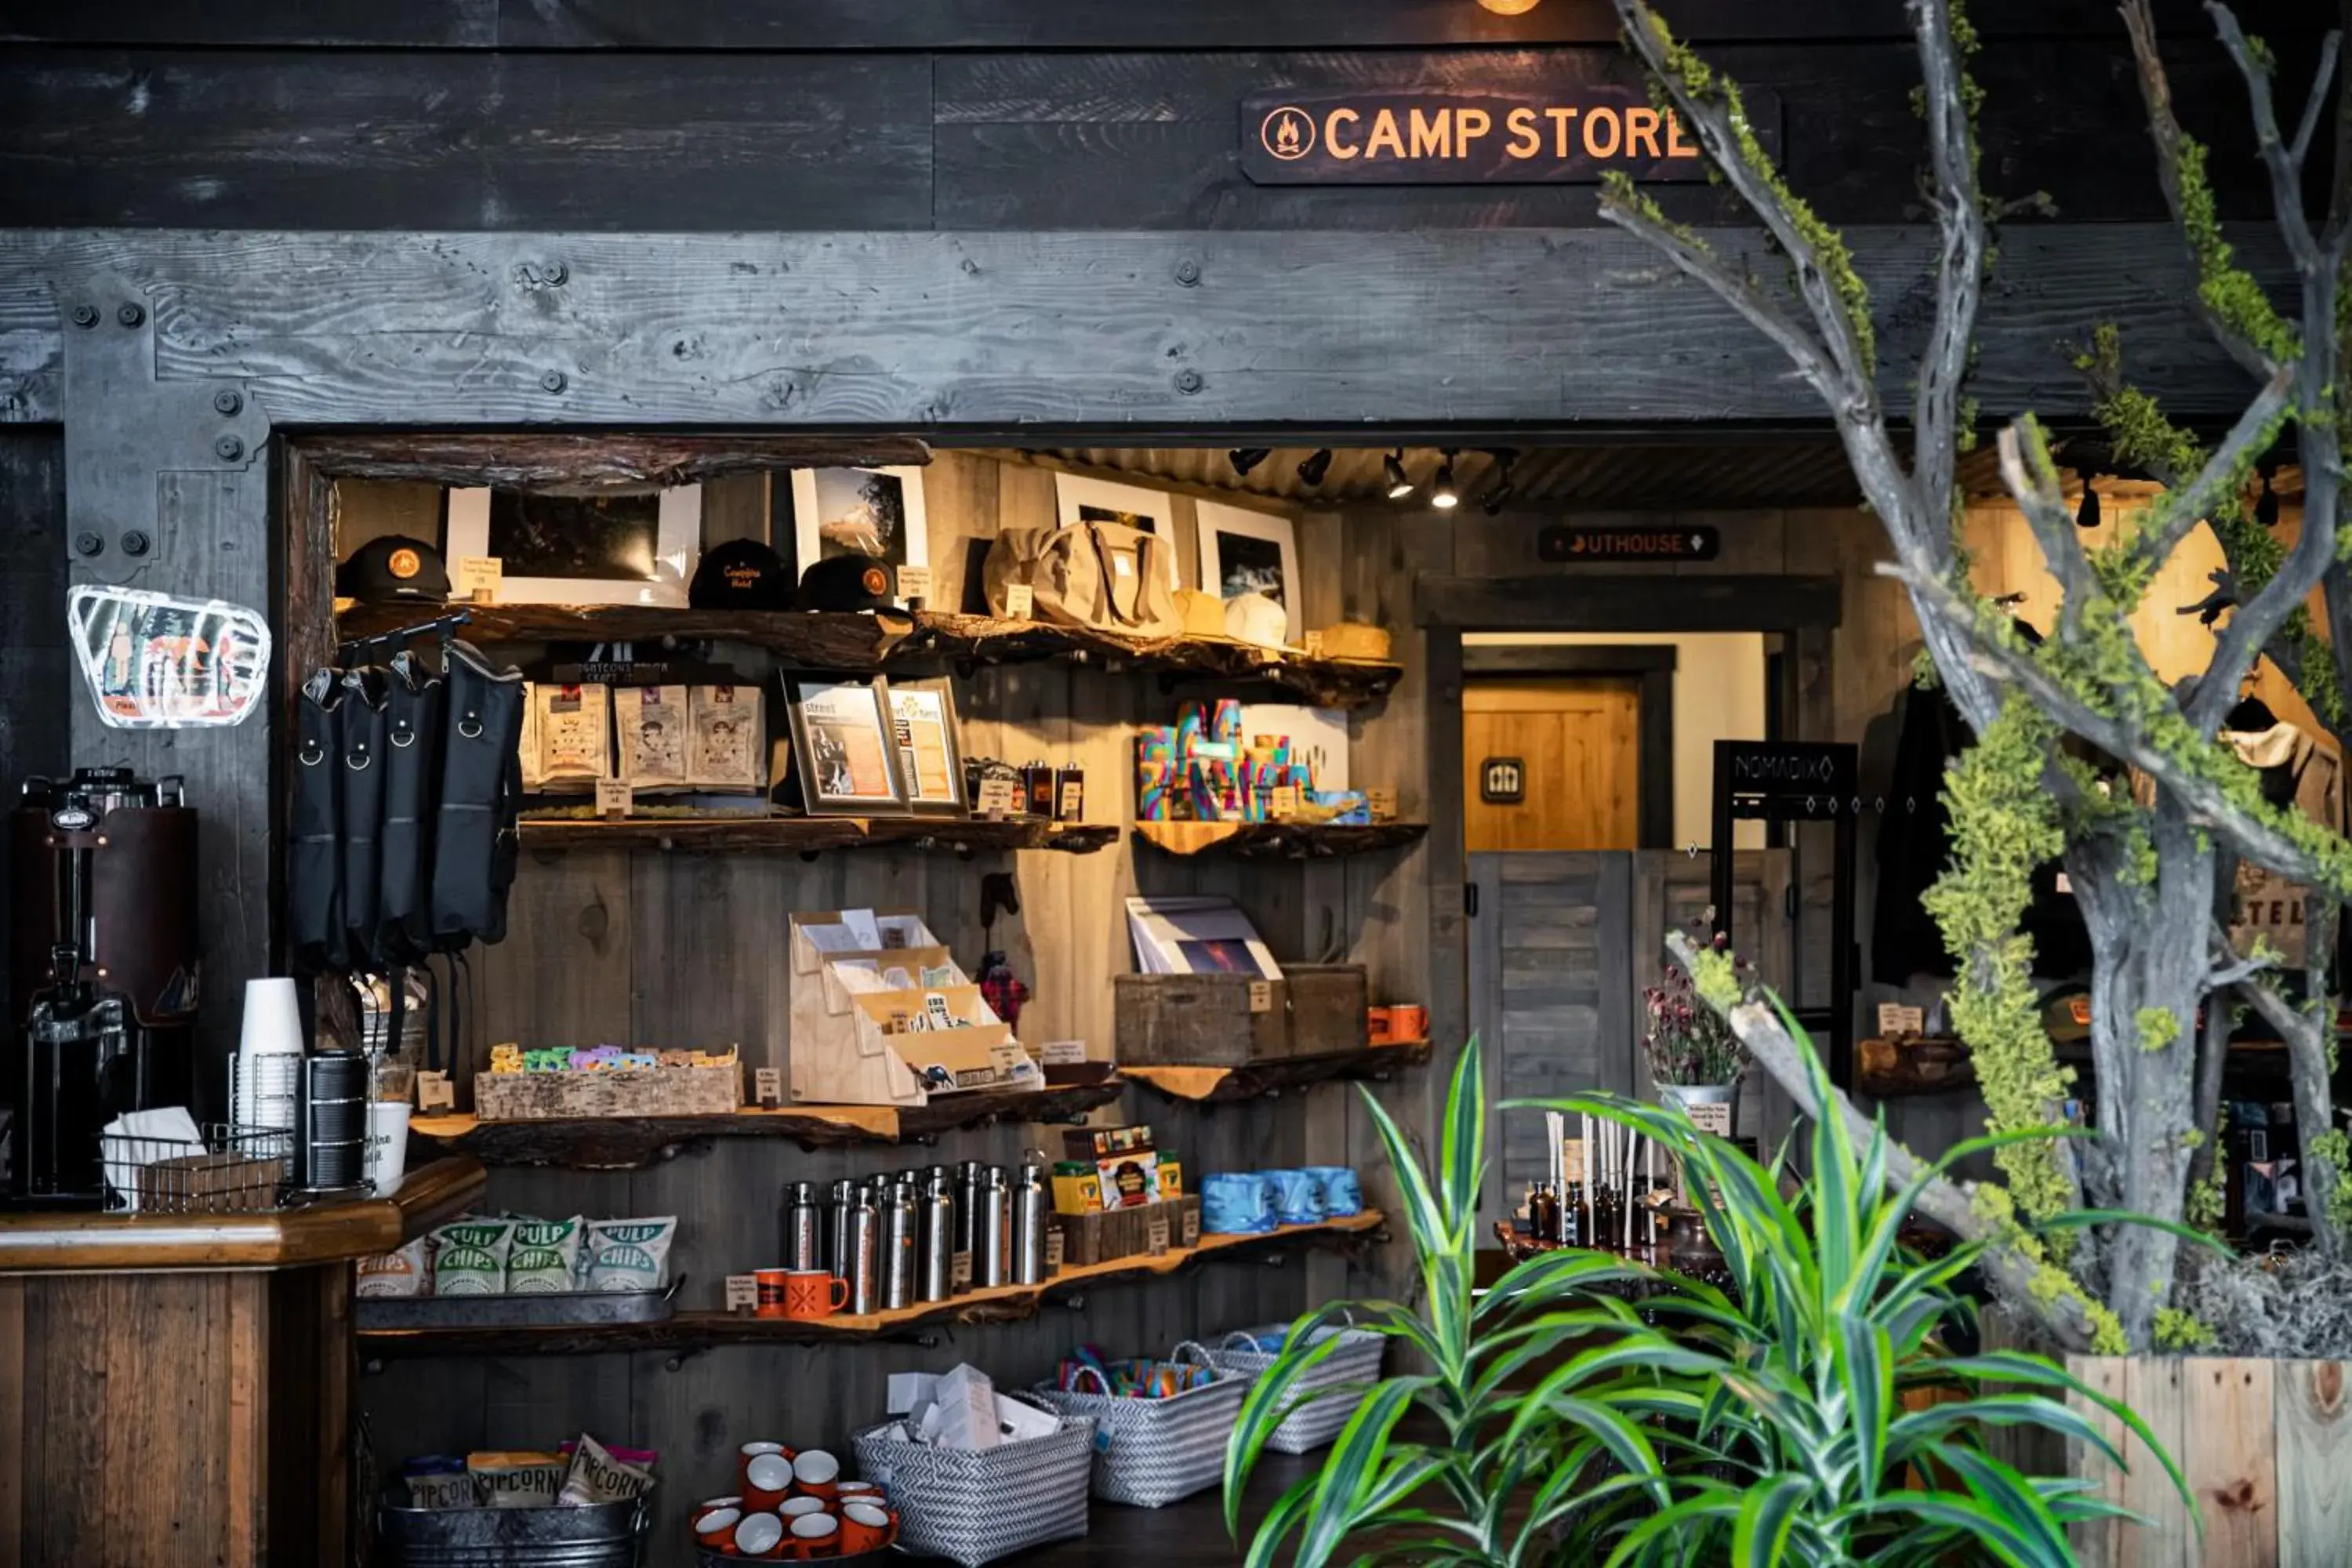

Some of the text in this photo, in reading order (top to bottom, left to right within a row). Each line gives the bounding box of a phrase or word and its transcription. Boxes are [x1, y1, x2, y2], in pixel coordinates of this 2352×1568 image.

[1325, 108, 1490, 158] CAMP
[517, 1225, 565, 1245] PULP
[606, 1225, 655, 1241] PULP
[444, 1249, 492, 1268] CHIPS
[513, 1251, 561, 1269] CHIPS
[600, 1247, 650, 1269] CHIPS
[476, 1469, 560, 1494] PIPCORN
